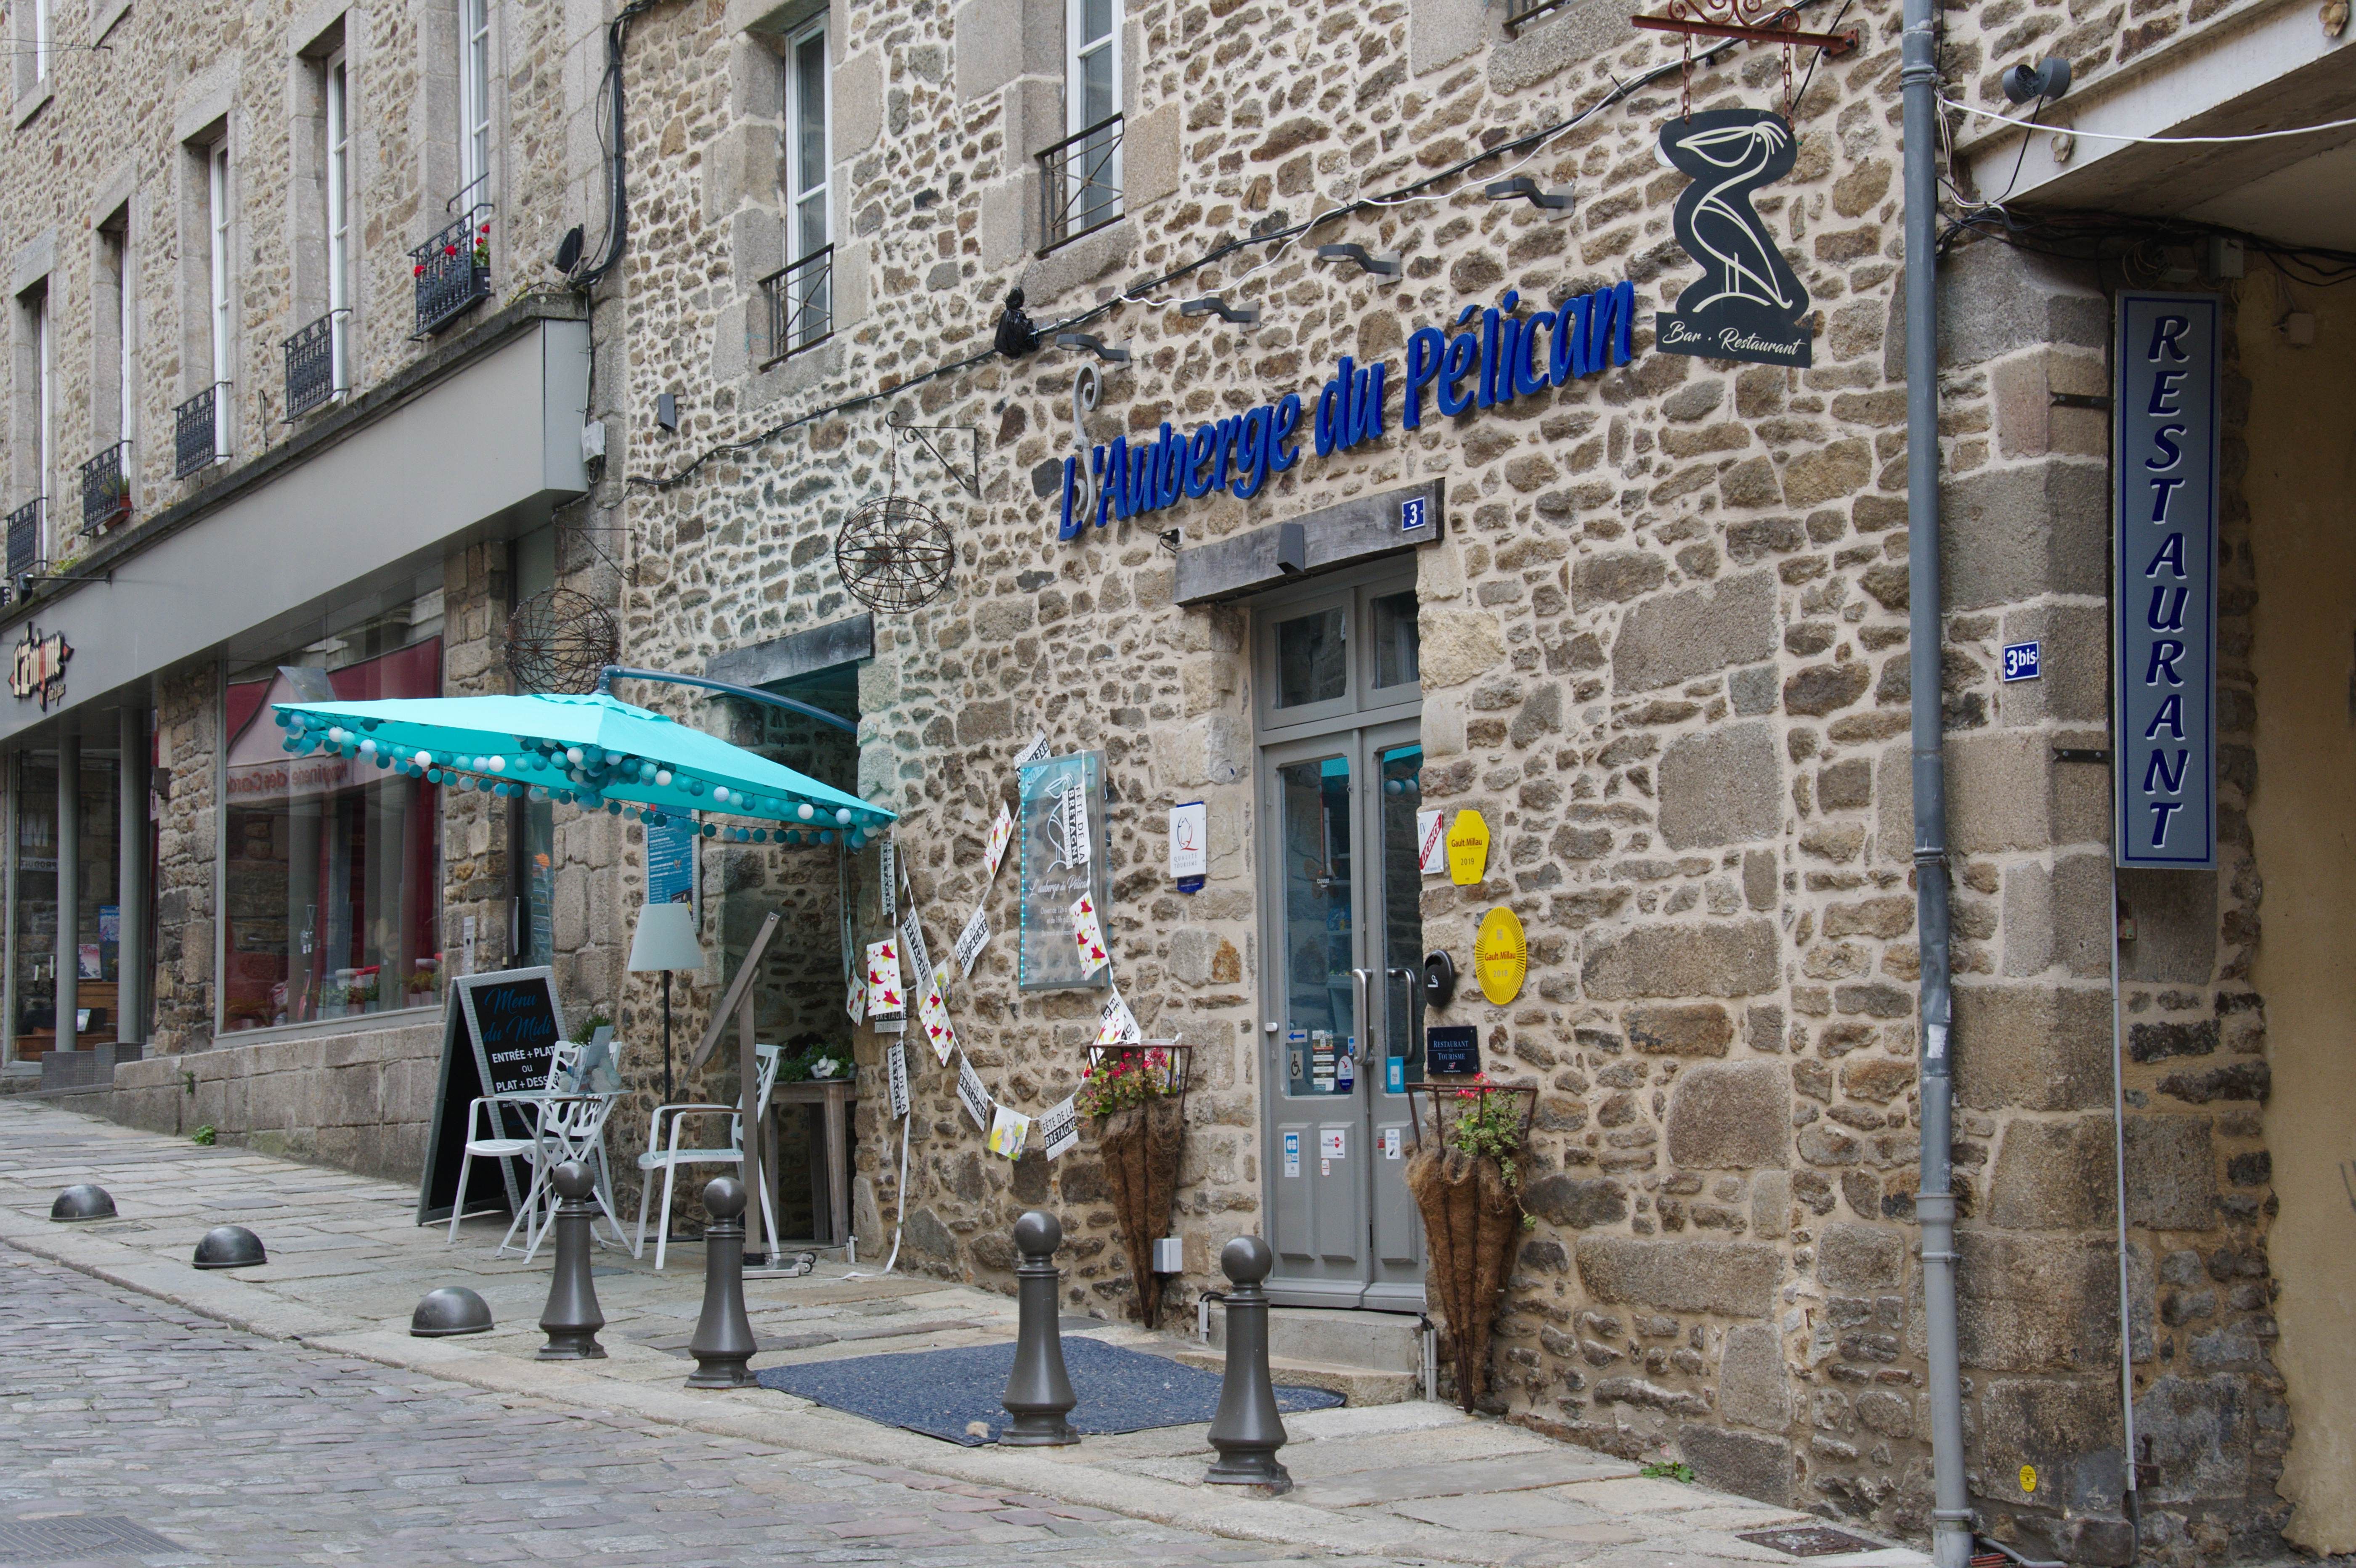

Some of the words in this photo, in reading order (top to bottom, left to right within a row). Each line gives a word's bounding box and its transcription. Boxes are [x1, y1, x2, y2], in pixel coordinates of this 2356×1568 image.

[1662, 321, 1701, 344] Bar
[1719, 327, 1807, 355] Restaurant
[1060, 393, 1300, 540] L'Auberge
[1316, 356, 1384, 458] du
[1403, 280, 1634, 431] Pélican
[1410, 504, 1417, 524] 3
[2143, 315, 2191, 849] RESTAURANT
[2006, 648, 2036, 675] 3bis
[1069, 789, 1078, 865] BRETAGNE
[1077, 822, 1084, 838] DE
[1420, 823, 1426, 834] IV
[1079, 845, 1085, 861] LA
[1421, 819, 1440, 866] LICENCE
[1467, 837, 1482, 846] Millau
[1174, 861, 1197, 869] TOURISME
[969, 923, 976, 937] DE
[976, 912, 984, 924] LA
[905, 919, 926, 980] BRETAGNE
[1485, 952, 1498, 961] Gault
[1500, 951, 1516, 959] Millau
[485, 988, 537, 1014] Menu
[483, 1022, 503, 1043] du
[506, 1015, 551, 1042] Midi
[492, 1049, 526, 1063] ENTRÉE
[534, 1046, 555, 1057] PLAT
[496, 1080, 517, 1092] PLAT
[526, 1075, 559, 1088] DESSR
[892, 1047, 902, 1115] BRETAGNE
[899, 1075, 904, 1091] DE
[961, 1063, 972, 1085] FÊTE
[973, 1082, 979, 1094] DE
[980, 1096, 987, 1107] LA
[901, 1097, 906, 1111] LA
[959, 1075, 986, 1119] BRETAGNE
[1043, 1118, 1056, 1134] FÊTE
[1057, 1112, 1065, 1124] DE
[1066, 1105, 1074, 1117] LA
[1045, 1119, 1077, 1148] BRETAGNE
[1287, 1139, 1297, 1150] CB
[1048, 1144, 1063, 1160] GOUEL
